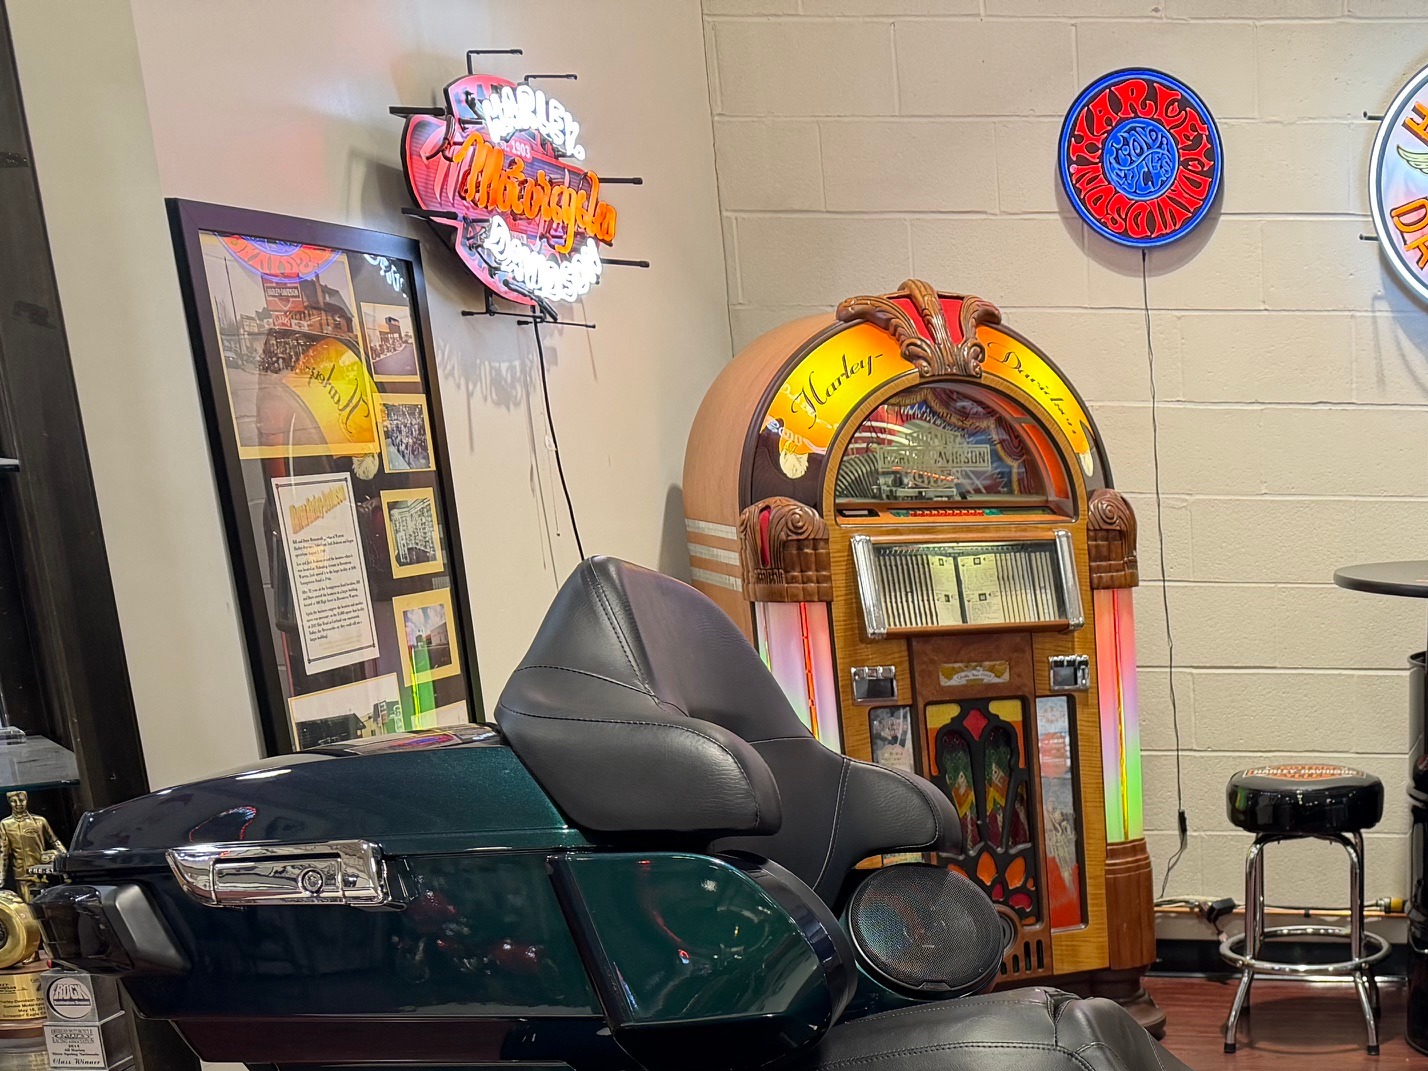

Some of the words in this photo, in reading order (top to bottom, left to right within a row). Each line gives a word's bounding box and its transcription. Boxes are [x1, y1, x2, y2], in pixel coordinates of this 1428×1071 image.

[511, 139, 532, 159] 1903
[53, 983, 91, 1000] ROCK
[75, 1057, 100, 1065] Winner
